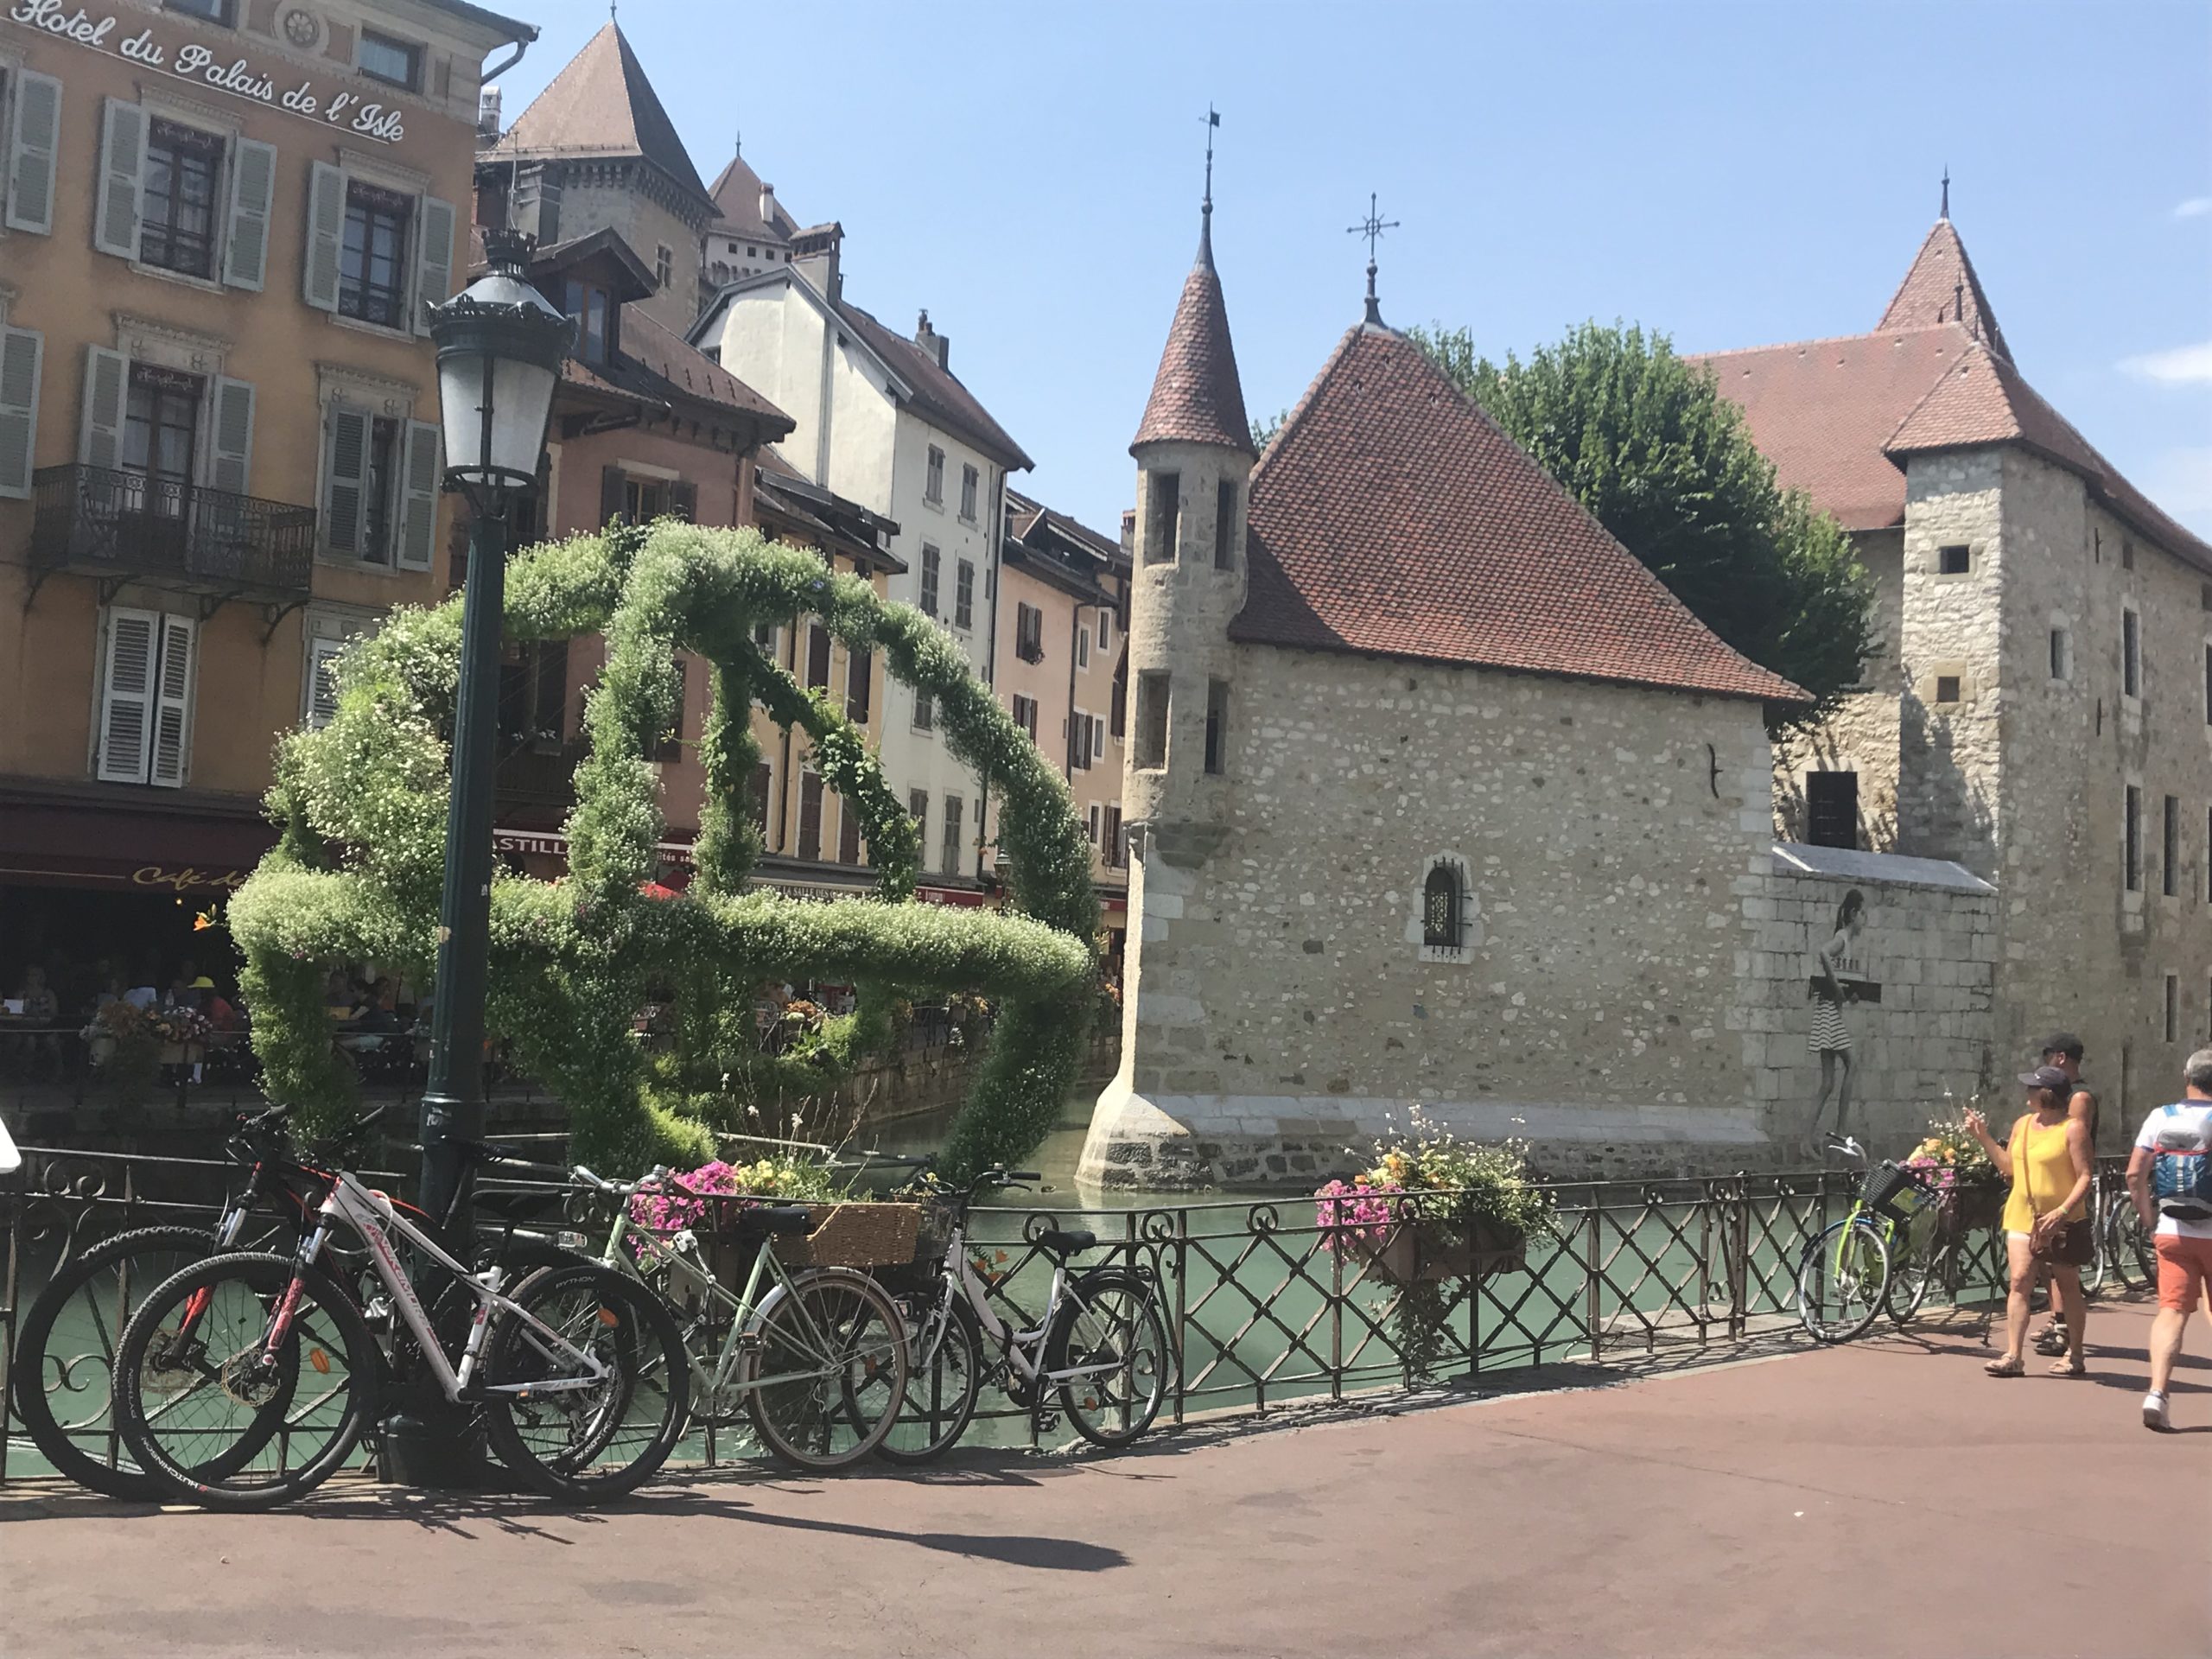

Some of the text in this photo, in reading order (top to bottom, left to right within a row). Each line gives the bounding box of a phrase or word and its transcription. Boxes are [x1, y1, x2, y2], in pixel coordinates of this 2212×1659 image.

[10, 0, 404, 141] Hotel du Palais de l'Isle
[132, 867, 207, 891] Café
[783, 886, 792, 895] LA
[793, 887, 814, 897] SALLE
[816, 888, 830, 899] DES
[556, 1275, 596, 1289] PYTHON
[141, 1436, 199, 1489] HUTCHINSON
